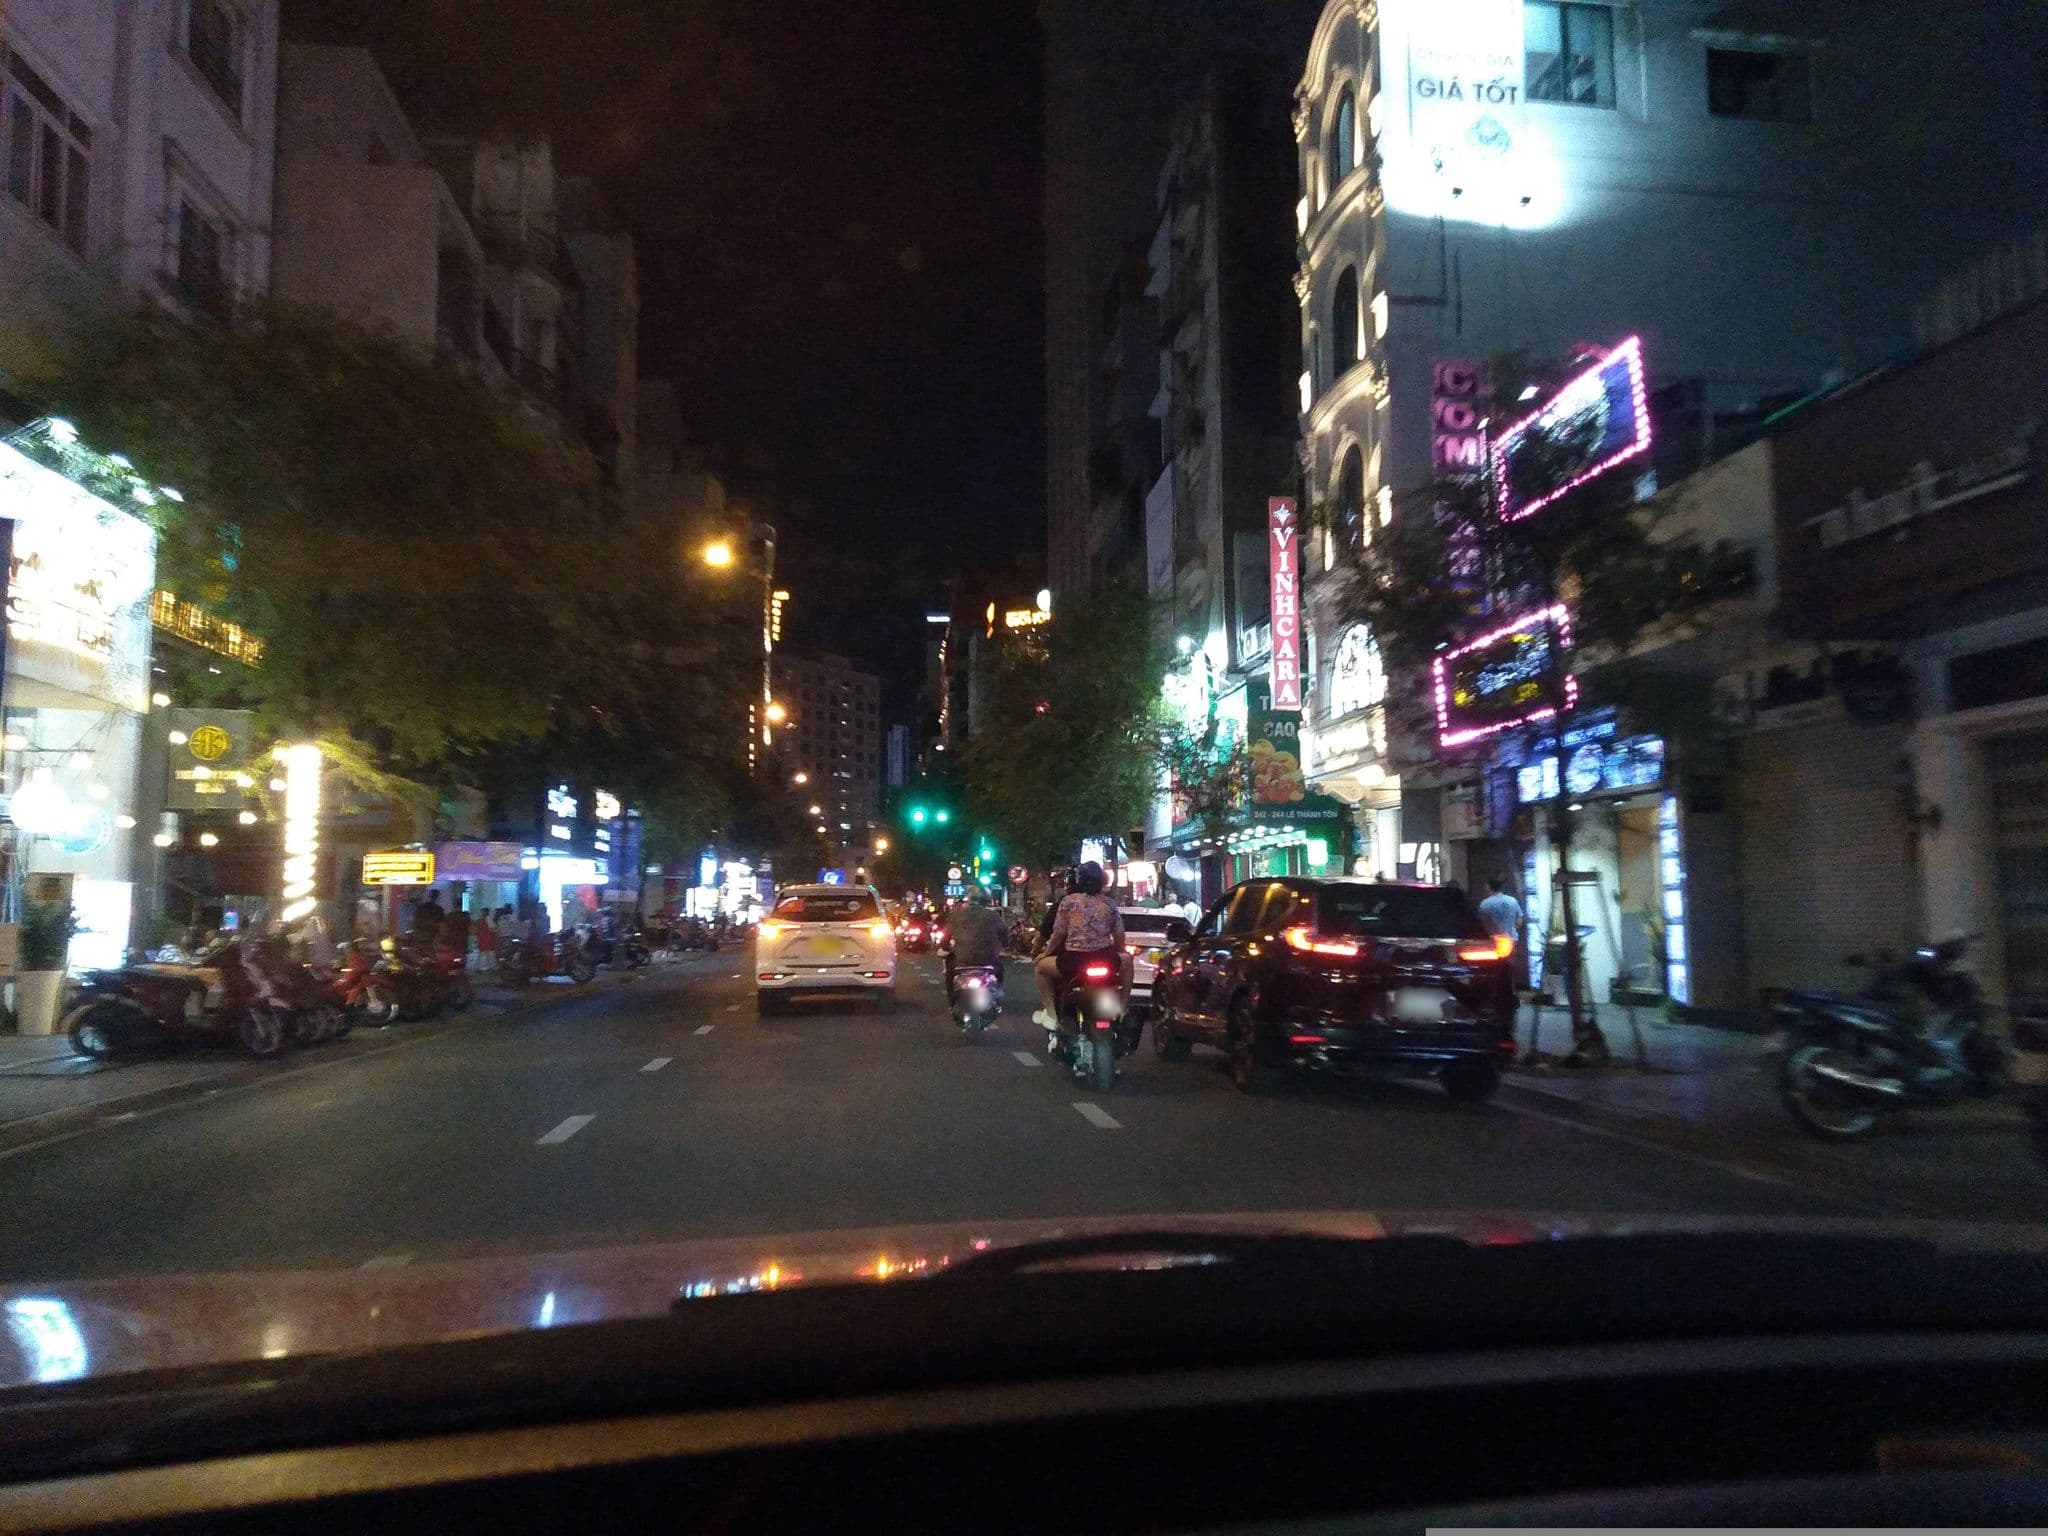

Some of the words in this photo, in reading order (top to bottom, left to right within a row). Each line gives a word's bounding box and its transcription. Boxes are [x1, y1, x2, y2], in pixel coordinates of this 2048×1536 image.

[1416, 75, 1463, 101] GIÁ
[1472, 76, 1518, 105] TỐT
[1271, 527, 1297, 703] VINHCARA
